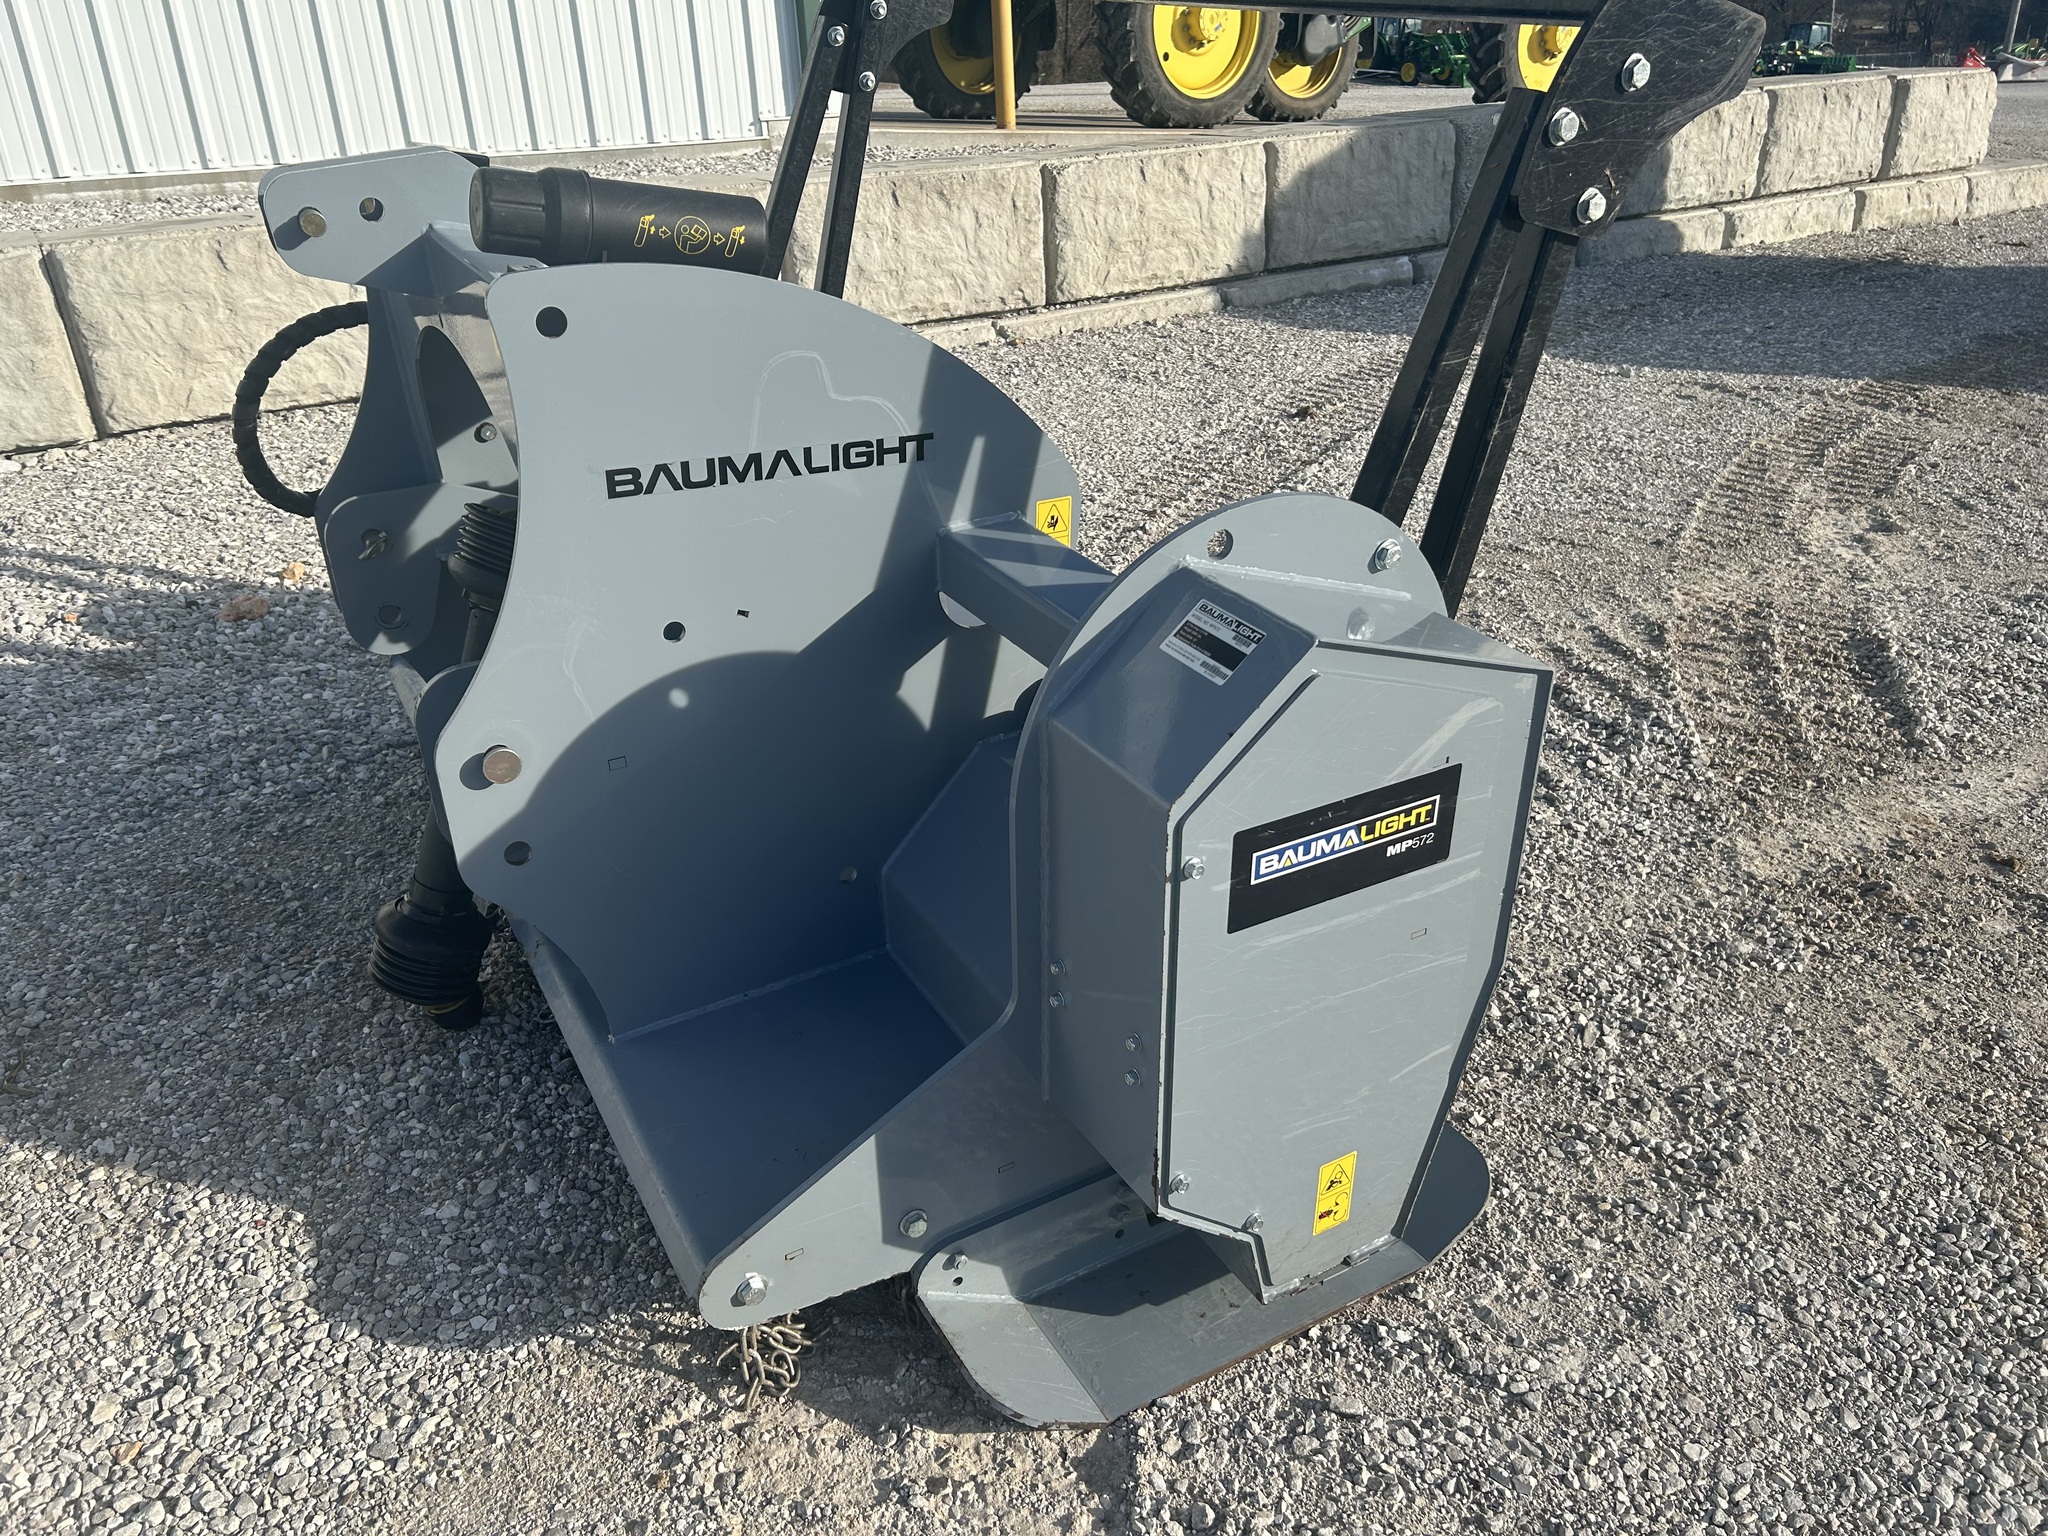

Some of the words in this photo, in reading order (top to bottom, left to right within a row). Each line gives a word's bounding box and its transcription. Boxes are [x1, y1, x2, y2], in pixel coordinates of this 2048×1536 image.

[605, 432, 934, 499] BAUMALIGHT
[1198, 603, 1263, 643] BAUMALIGHT
[1259, 804, 1432, 875] BAUMALIGHT
[1386, 832, 1435, 857] MP572
